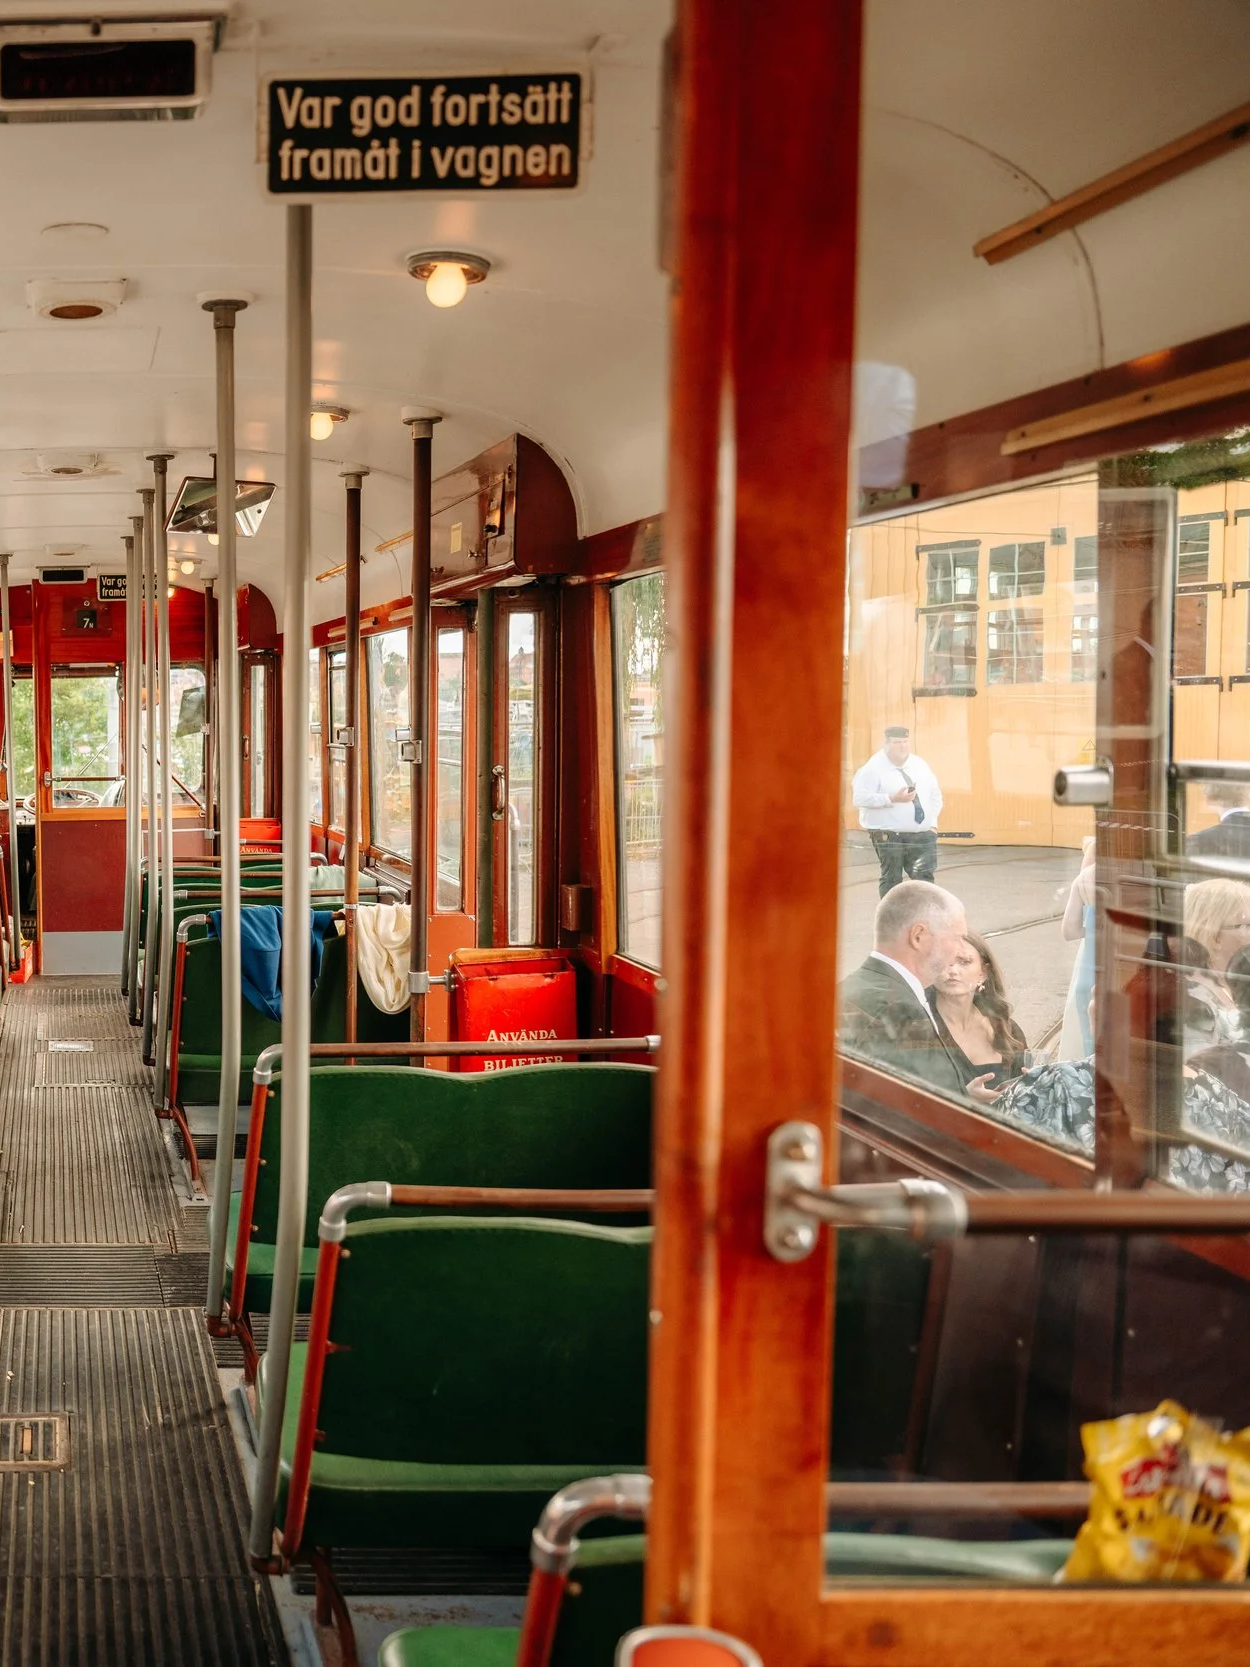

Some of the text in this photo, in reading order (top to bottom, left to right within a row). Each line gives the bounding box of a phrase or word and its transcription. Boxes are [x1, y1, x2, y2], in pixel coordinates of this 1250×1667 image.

[277, 81, 573, 137] Var god fortsätt
[279, 138, 571, 187] framåt i vagnen
[101, 576, 126, 587] Var go
[102, 587, 126, 596] framå
[486, 1029, 558, 1043] ANVÄNDA
[483, 1055, 563, 1071] BILJETTER
